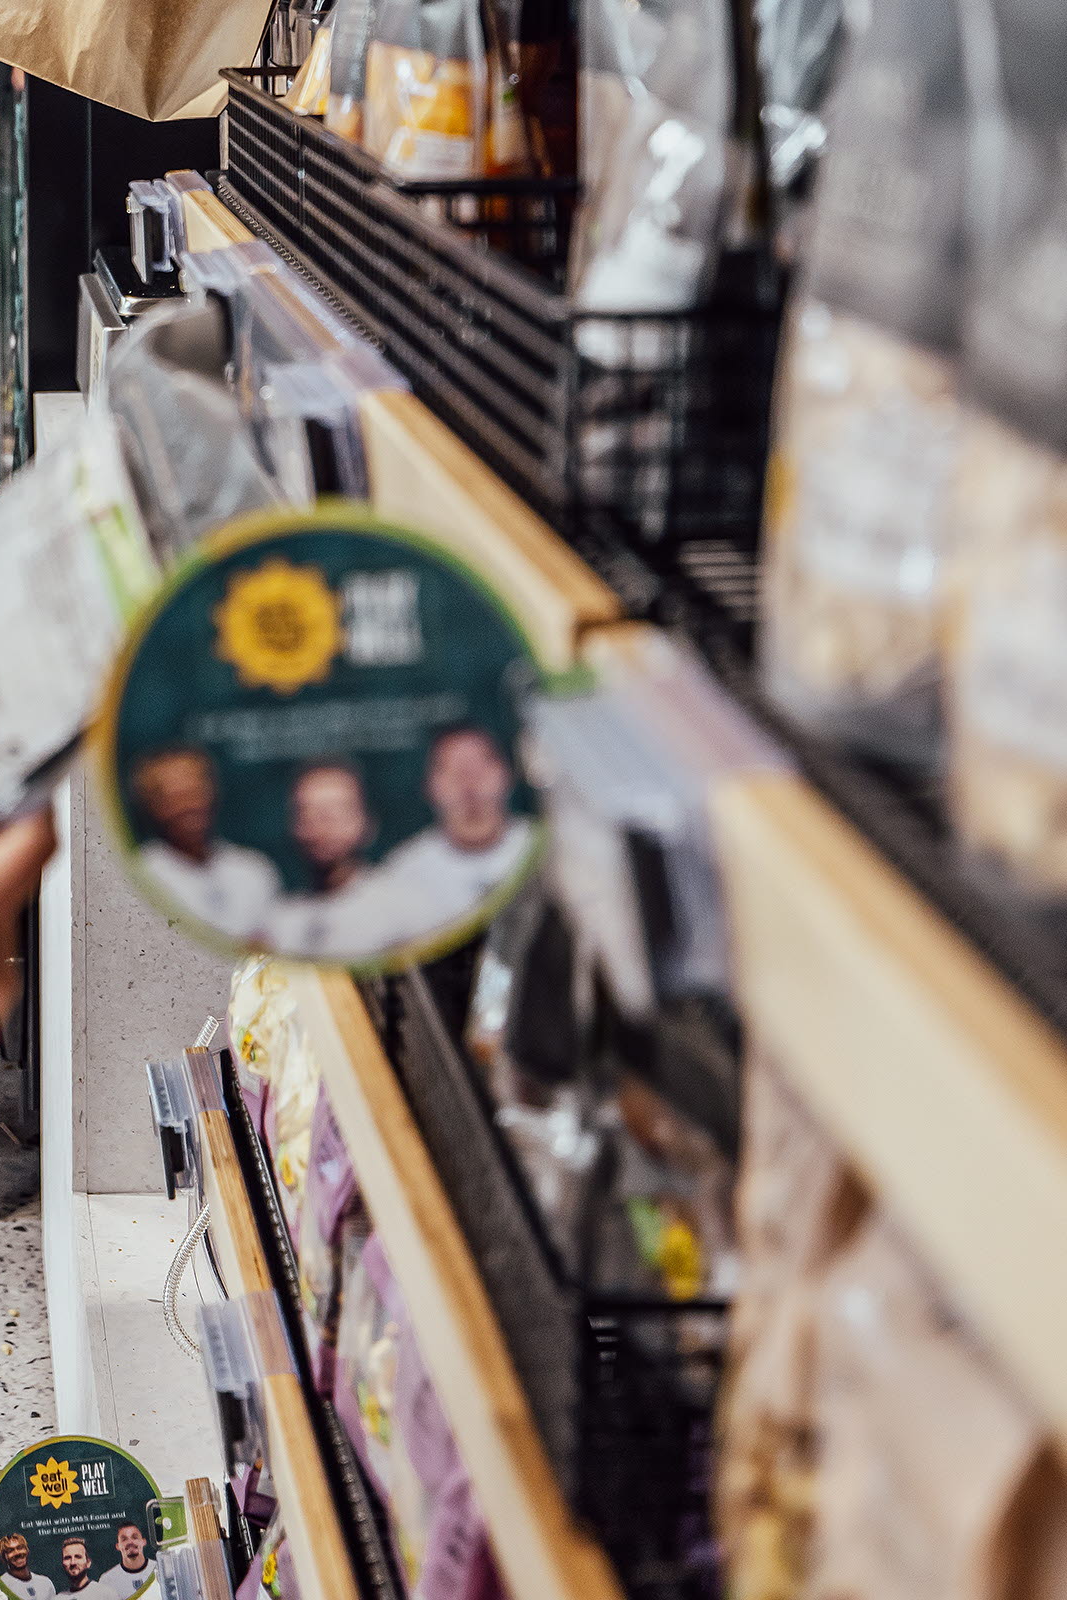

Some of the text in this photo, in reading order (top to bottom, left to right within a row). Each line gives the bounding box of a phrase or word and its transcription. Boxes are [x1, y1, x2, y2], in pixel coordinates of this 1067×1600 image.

[41, 1469, 62, 1482] eat
[81, 1462, 106, 1480] PLAY
[42, 1478, 68, 1492] well
[82, 1478, 109, 1496] WELL
[21, 1511, 126, 1529] Eat Well with M&S Food and
[38, 1522, 111, 1536] the England Teams
